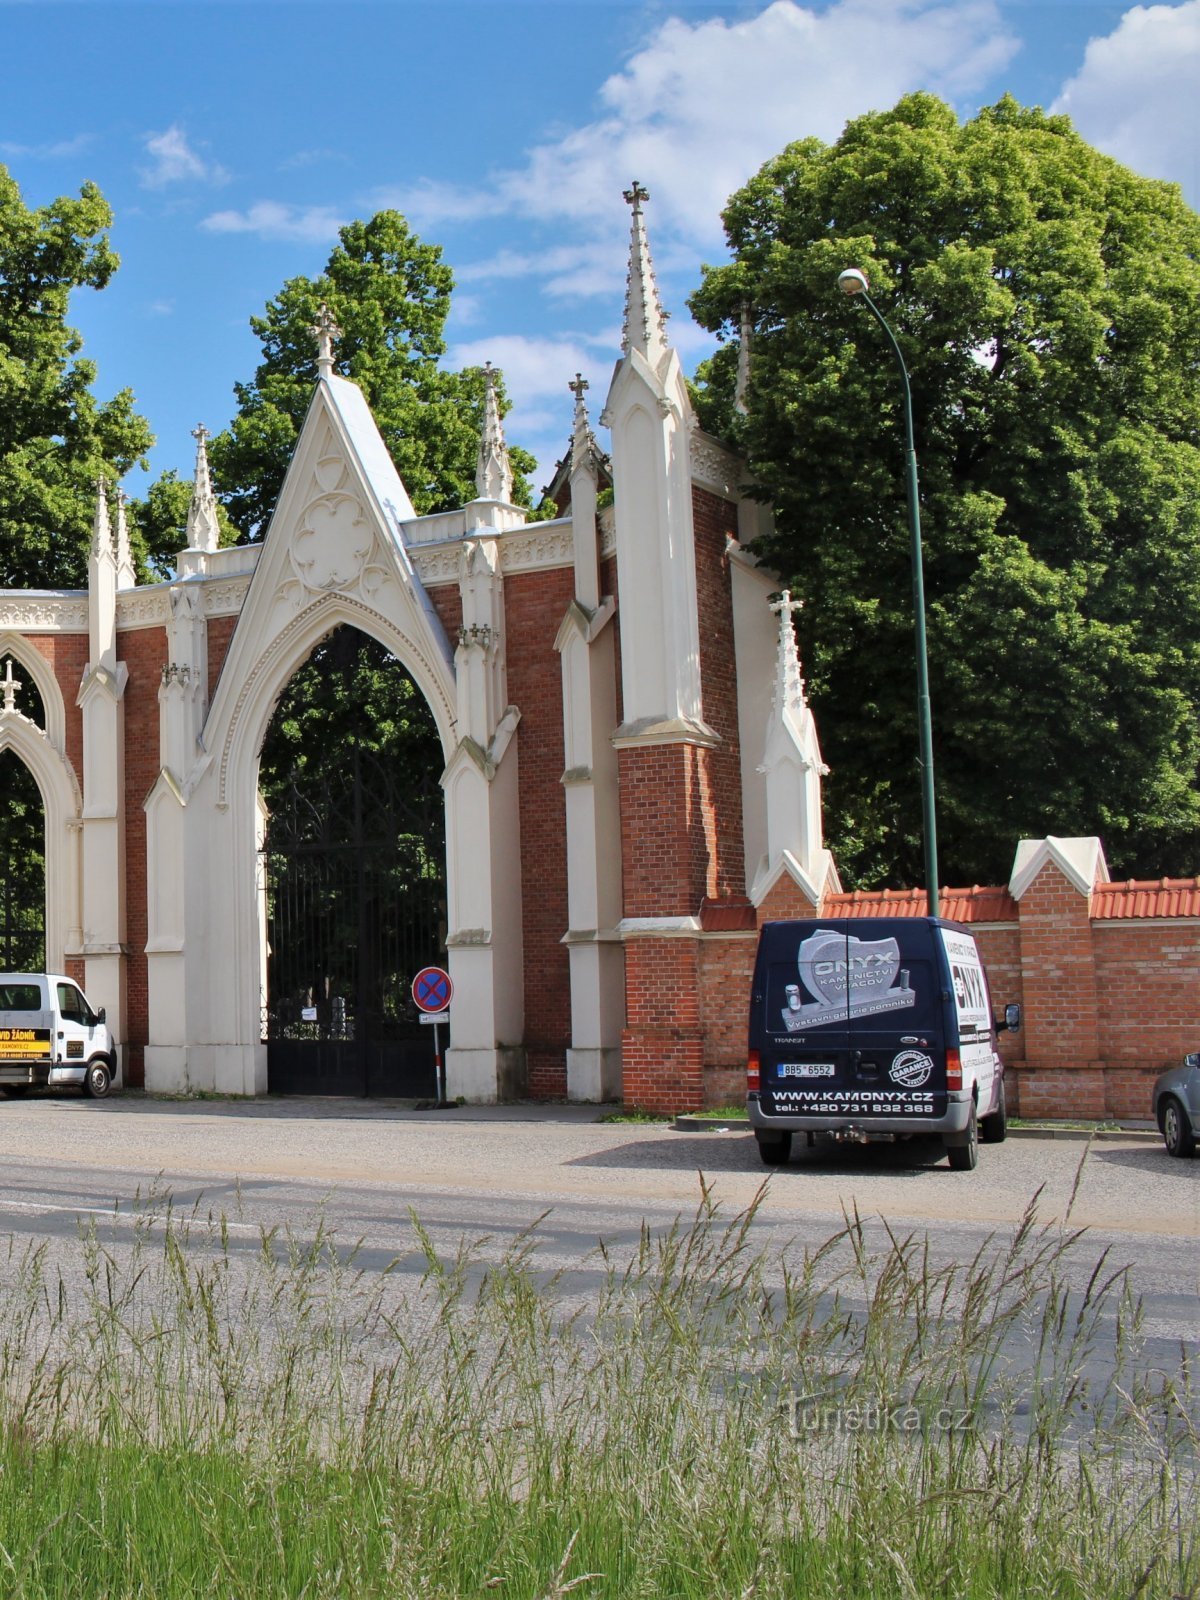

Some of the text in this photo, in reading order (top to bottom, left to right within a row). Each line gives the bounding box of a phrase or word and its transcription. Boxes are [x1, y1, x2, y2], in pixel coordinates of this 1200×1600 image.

[814, 951, 894, 976] ONYX
[834, 978, 884, 991] VRACOV
[833, 1007, 867, 1020] galerie
[11, 1029, 36, 1041] ŽÁDNÍK
[785, 1065, 831, 1075] 8B5 6552
[892, 1059, 930, 1078] GARANCE
[772, 1091, 933, 1102] WWW.KAMONYX.CZ
[775, 1104, 933, 1113] tel.: +420 731 832 368
